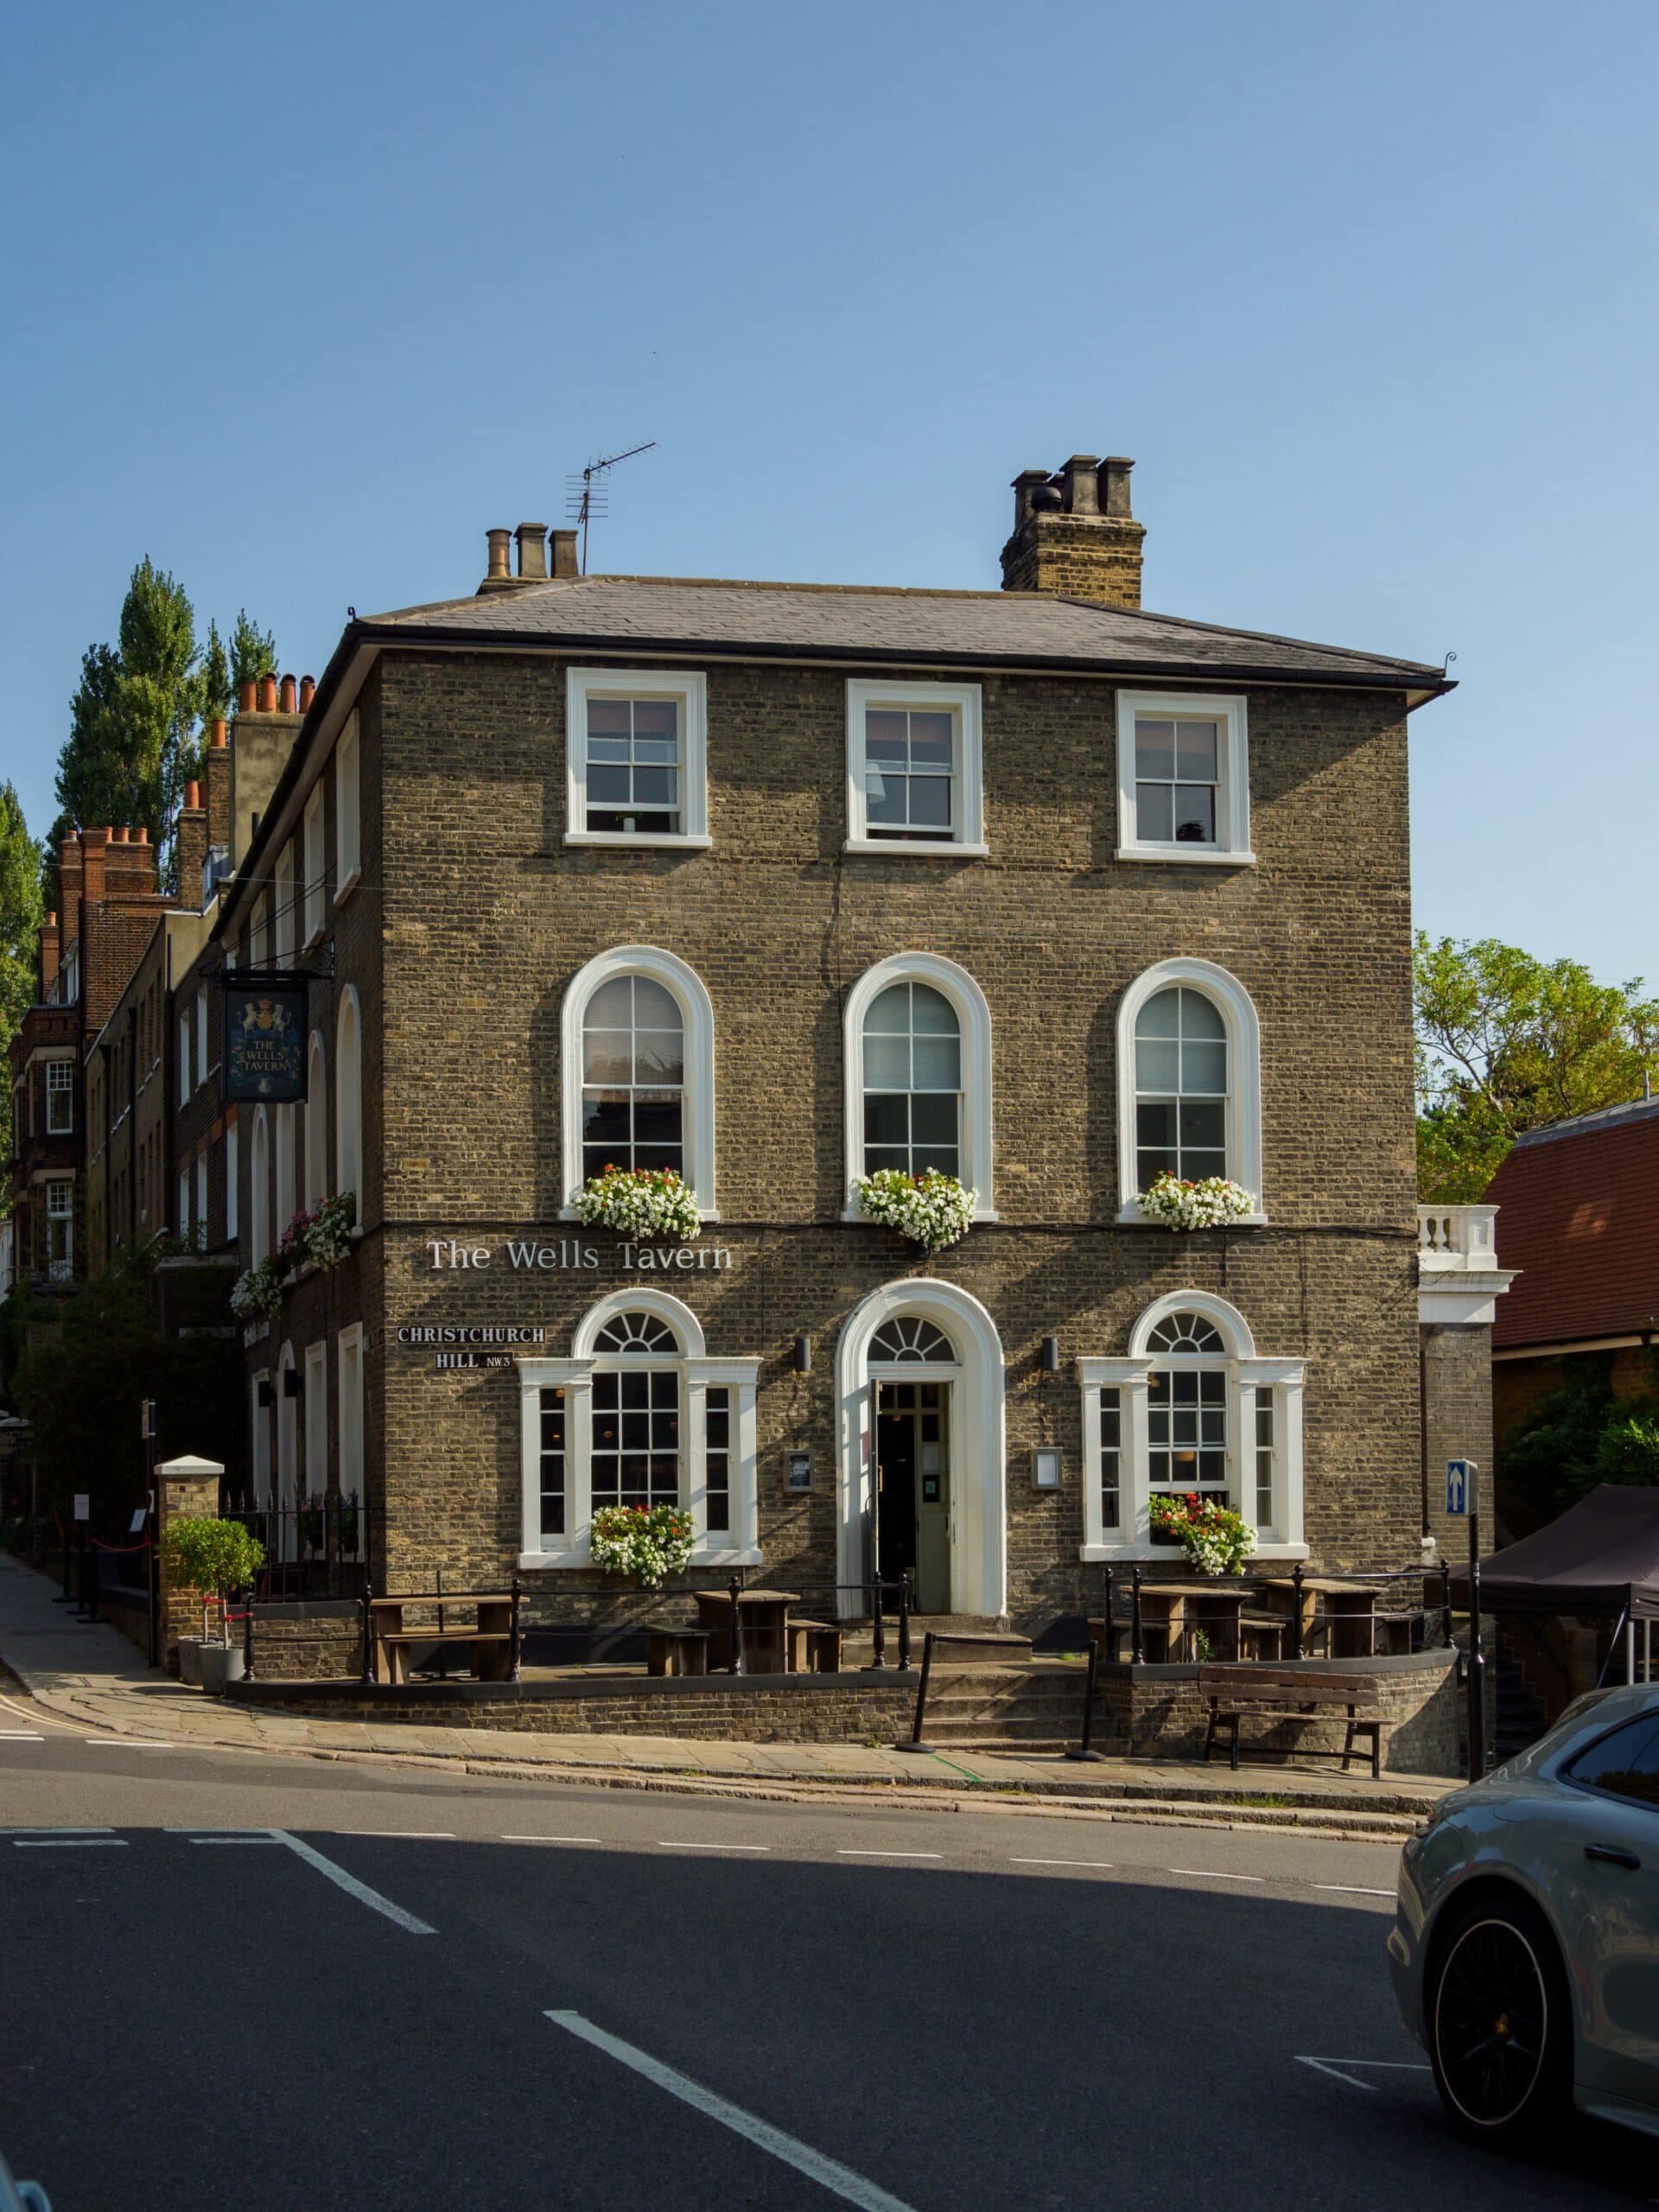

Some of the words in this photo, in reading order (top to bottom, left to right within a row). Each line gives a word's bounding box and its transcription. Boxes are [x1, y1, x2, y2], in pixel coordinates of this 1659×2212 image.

[254, 1040, 276, 1050] THE
[246, 1051, 284, 1060] WELLS
[245, 1062, 286, 1071] TAVERN
[427, 1239, 491, 1269] The
[506, 1239, 599, 1269] Wells
[617, 1243, 732, 1269] Tavern
[397, 1328, 544, 1343] CHRISTCHURCH
[436, 1353, 479, 1369] HILL
[486, 1357, 511, 1368] NW3
